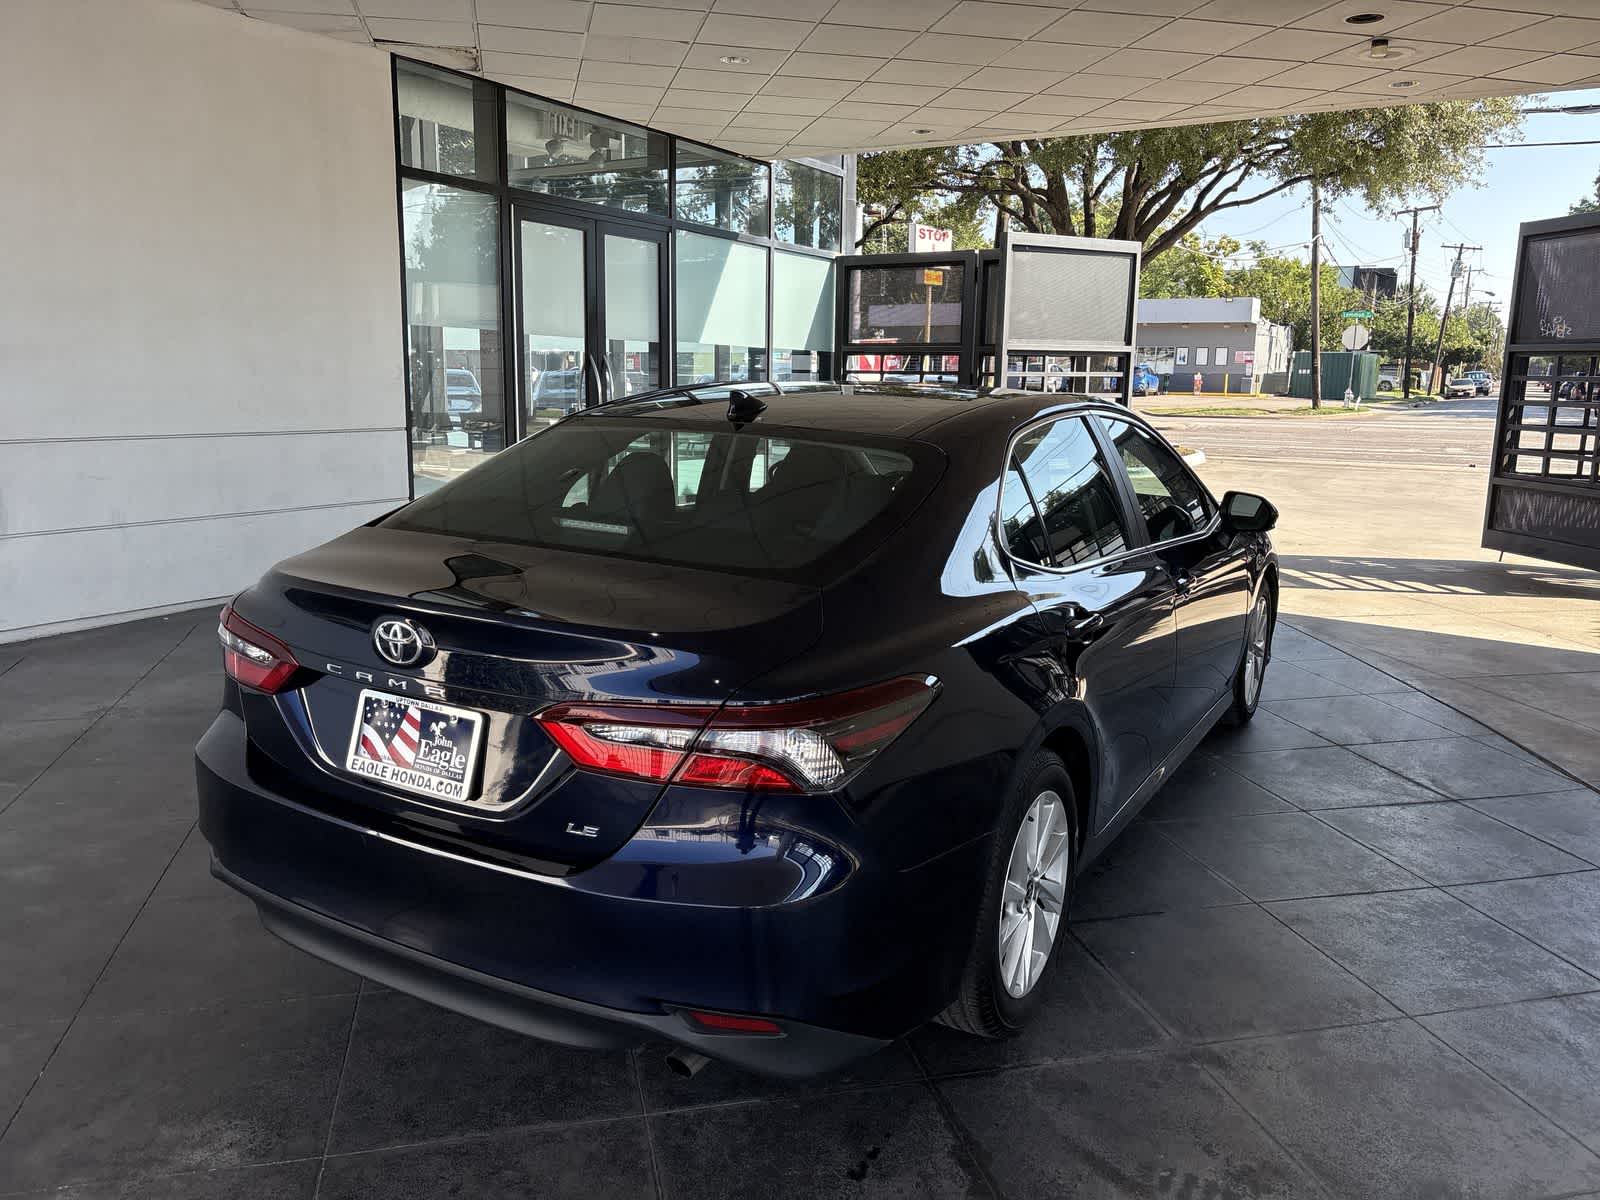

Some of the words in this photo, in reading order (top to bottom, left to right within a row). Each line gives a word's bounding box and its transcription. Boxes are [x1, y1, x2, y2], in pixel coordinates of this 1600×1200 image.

[918, 228, 949, 241] STOP
[327, 663, 446, 697] CAMR
[396, 697, 420, 707] UPTOWN
[432, 735, 453, 749] John
[416, 738, 466, 771] Eagle
[391, 769, 463, 798] HONDA.COM
[566, 822, 600, 837] LE
